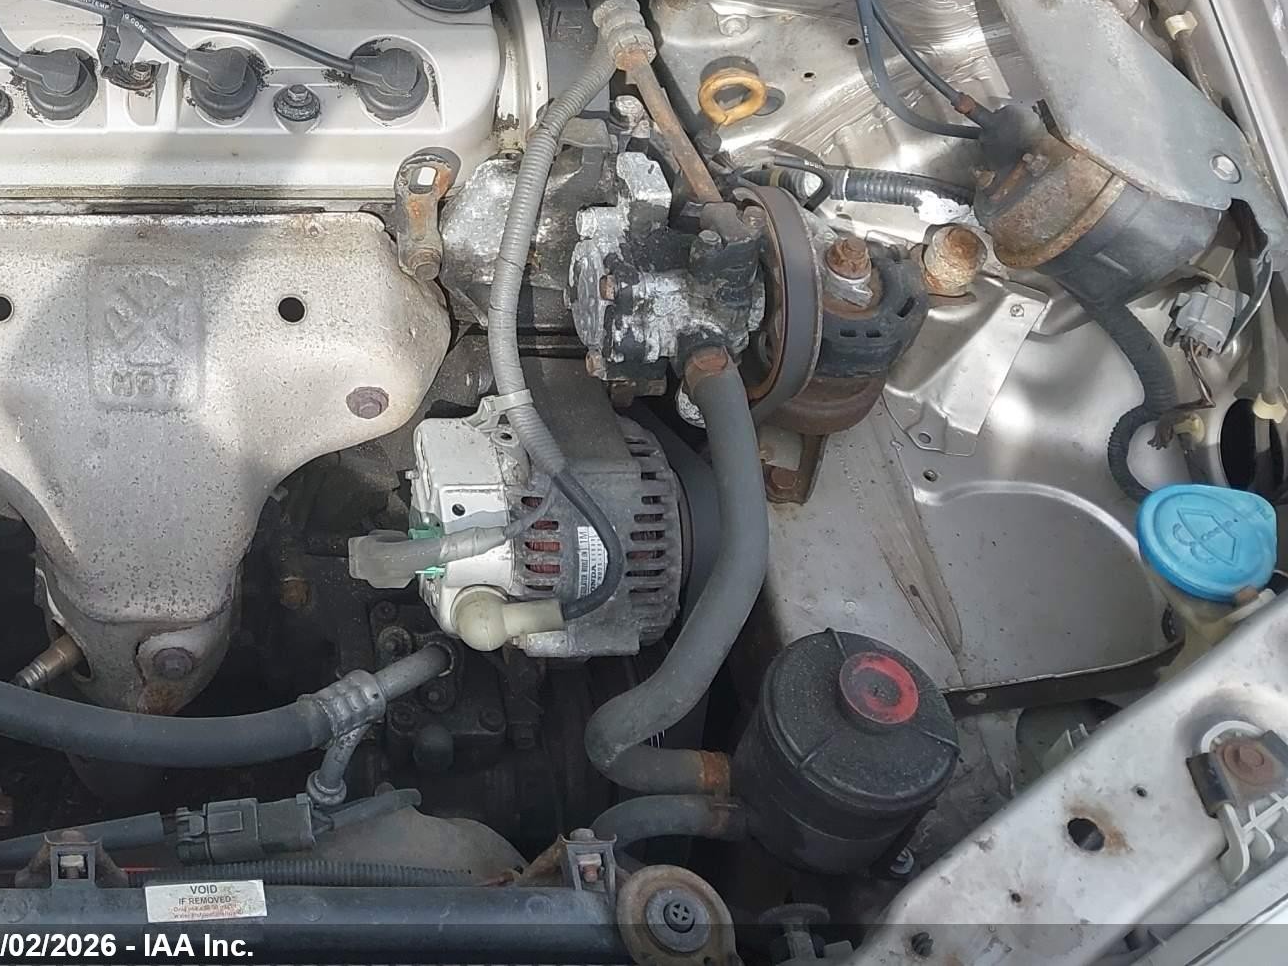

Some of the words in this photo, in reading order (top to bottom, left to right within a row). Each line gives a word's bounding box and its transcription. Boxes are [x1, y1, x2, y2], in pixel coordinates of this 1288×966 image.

[590, 563, 598, 593] ONDA
[190, 884, 218, 895] VOID
[178, 897, 188, 905] IF
[188, 895, 232, 905] REMOVED
